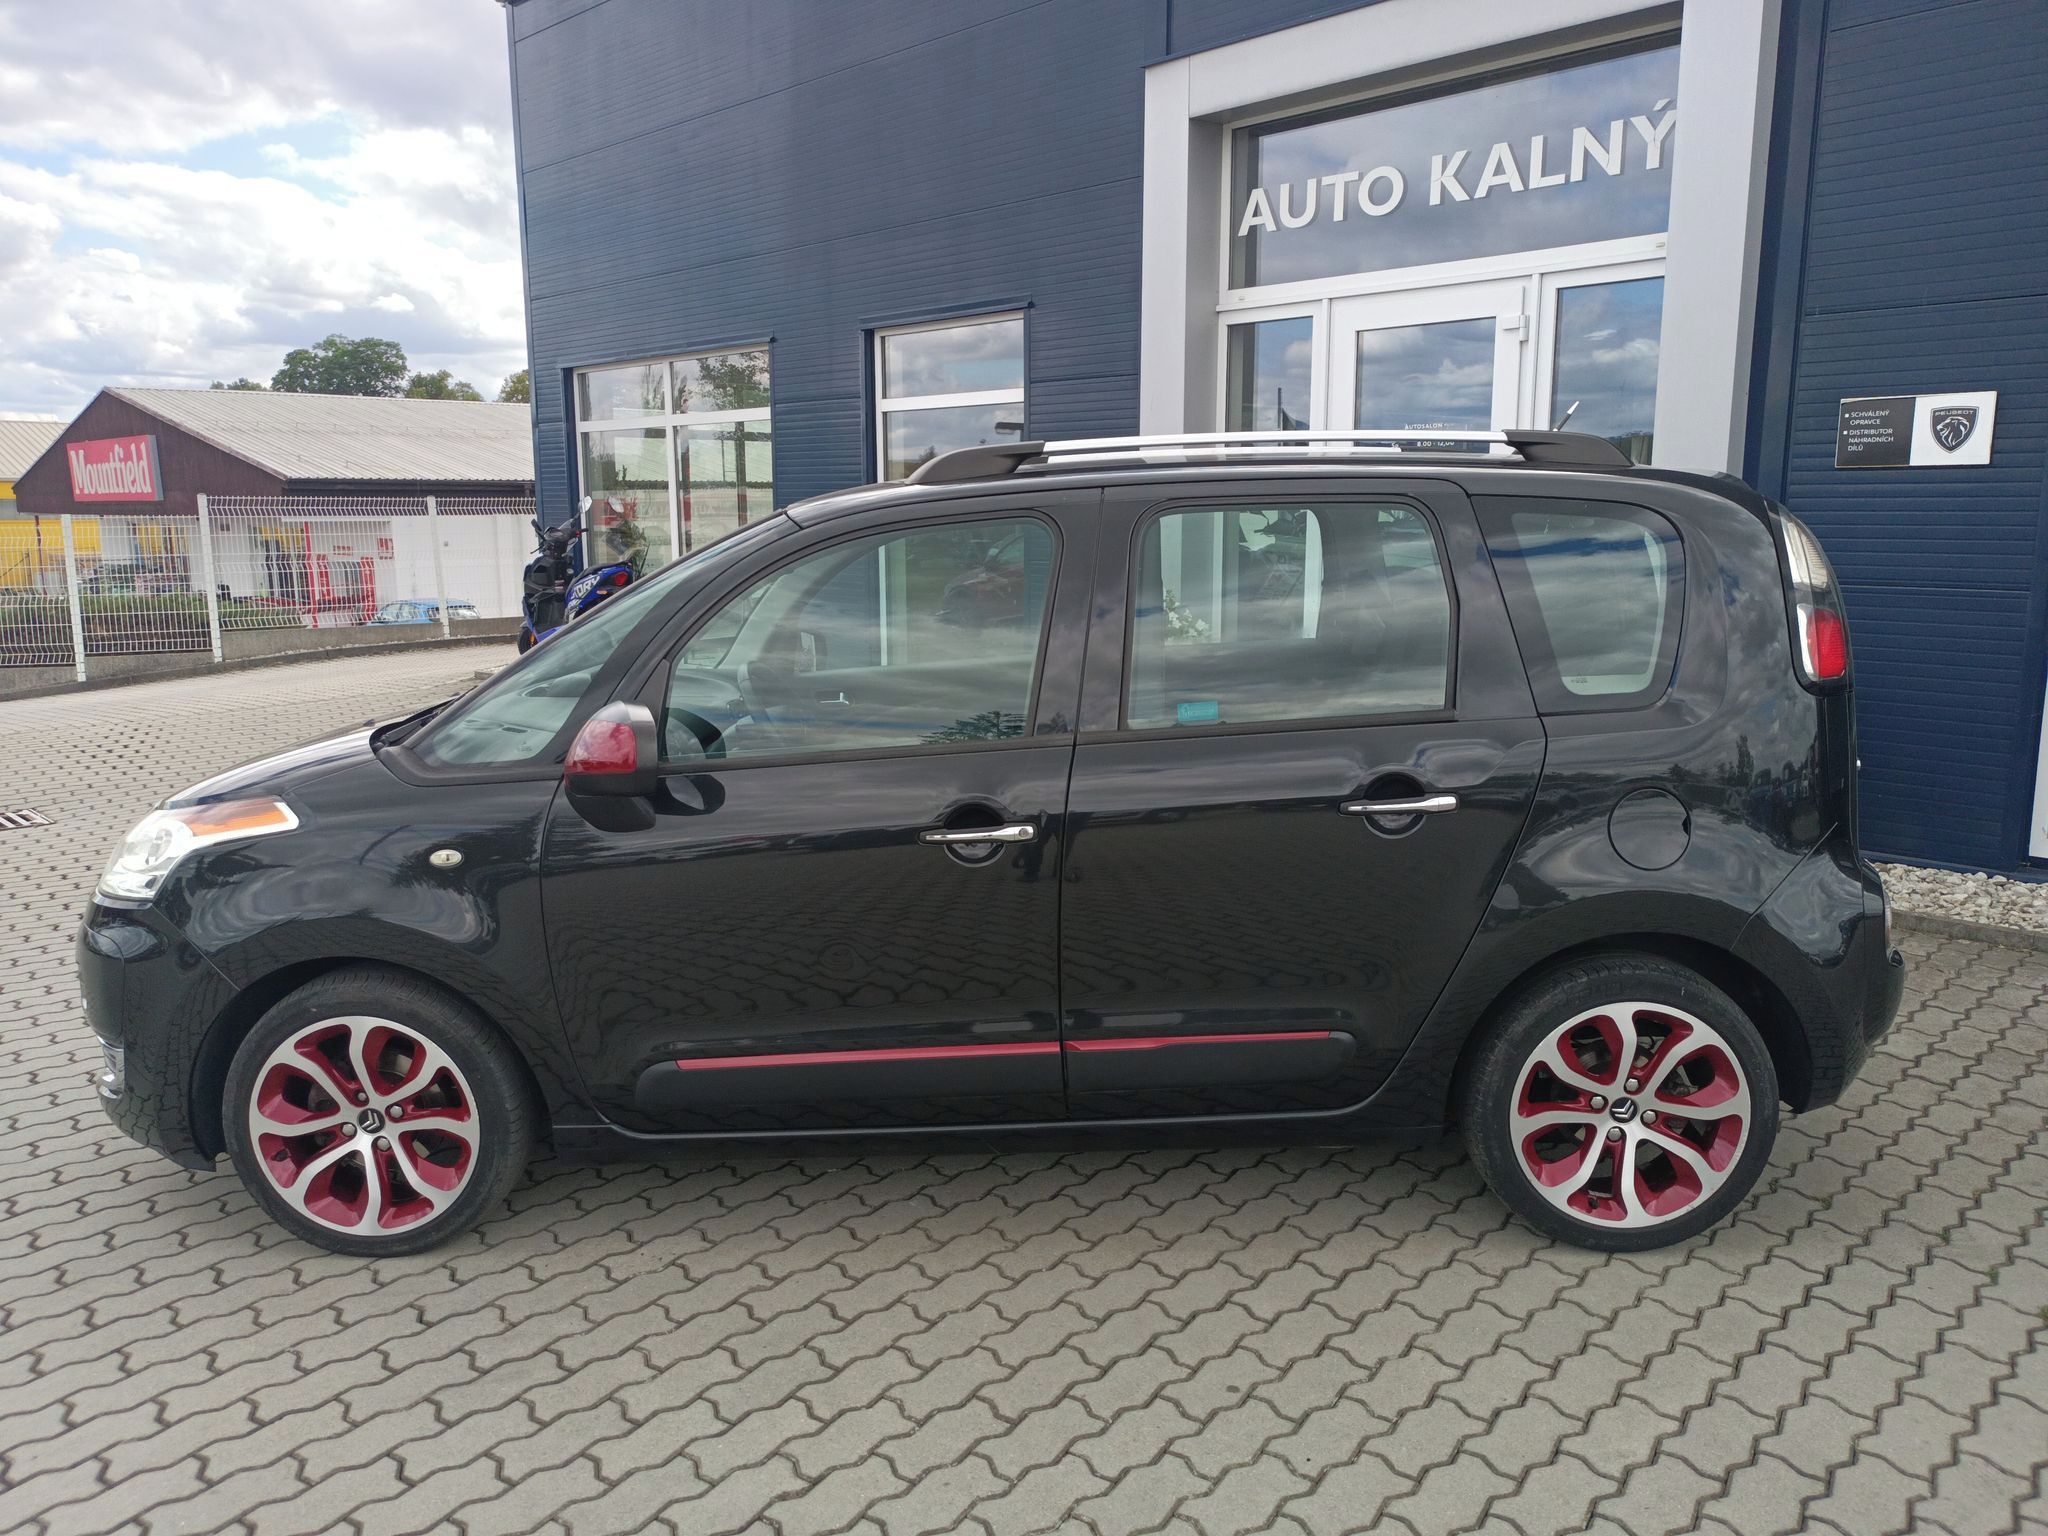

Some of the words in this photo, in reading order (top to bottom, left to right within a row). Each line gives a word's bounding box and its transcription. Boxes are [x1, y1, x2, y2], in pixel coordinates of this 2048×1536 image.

[1238, 166, 1406, 237] AUTO
[1429, 98, 1678, 207] KALNÝ
[1850, 409, 1890, 418] SCHVÁLENÝ
[1849, 418, 1881, 426] OPRAVCE
[1849, 428, 1893, 436] DISTRIBUTOR
[1848, 435, 1894, 443] NÁHRADNÍCH
[70, 442, 152, 495] Mountfield
